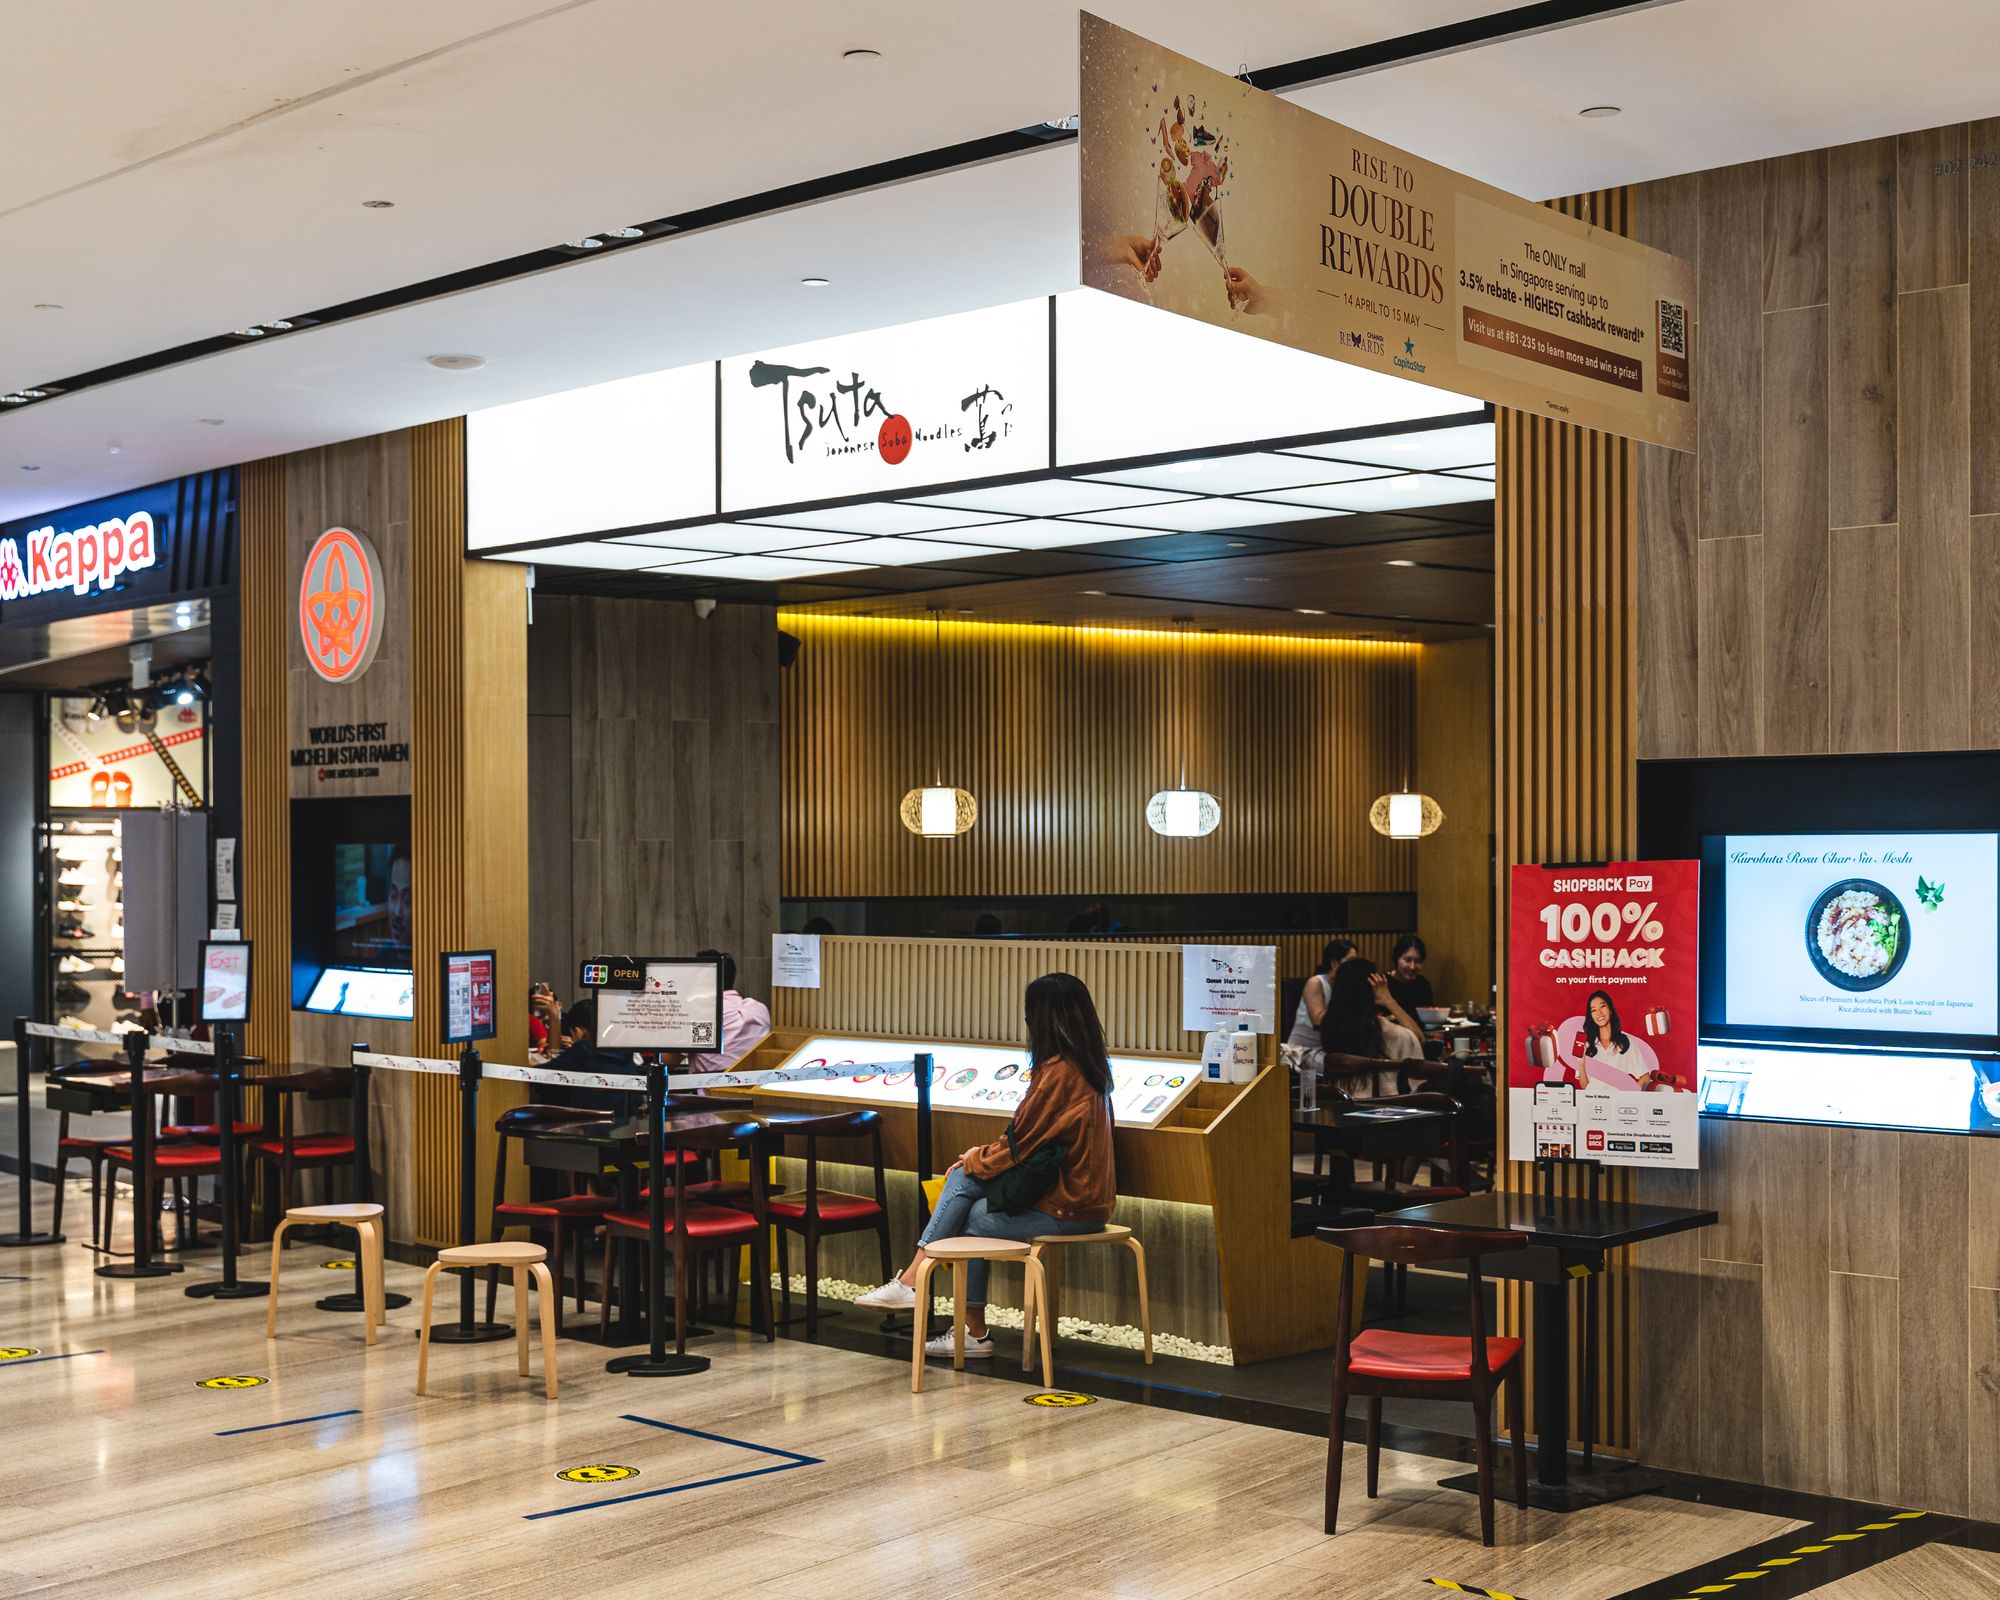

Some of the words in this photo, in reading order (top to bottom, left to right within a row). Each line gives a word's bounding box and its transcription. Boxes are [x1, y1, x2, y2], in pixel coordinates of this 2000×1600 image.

[1352, 148, 1388, 184] RISE
[1393, 165, 1414, 193] TO
[1329, 174, 1435, 252] DOUBLE
[1319, 223, 1444, 304] REWARDS
[1524, 242, 1540, 262] The
[1543, 250, 1567, 272] ONLY
[1569, 262, 1586, 279] mall
[1500, 258, 1508, 276] in
[1511, 262, 1553, 291] Singapore
[1556, 282, 1585, 306] serving
[1587, 293, 1598, 311] up
[1599, 295, 1609, 310] to
[1344, 293, 1353, 305] 14
[1355, 298, 1377, 315] APRIL
[1379, 303, 1390, 318] TO
[1392, 308, 1401, 322] 15
[1403, 312, 1421, 327] MAY
[1460, 269, 1485, 293] 3.5%
[1487, 281, 1517, 303] rebate
[1524, 291, 1564, 318] HIGHEST
[1566, 309, 1606, 333] cashback
[1467, 317, 1486, 335] Visit
[1486, 327, 1495, 337] us
[1497, 330, 1504, 341] at
[1505, 331, 1536, 351] #B1-235
[1537, 341, 1546, 353] to
[1547, 342, 1564, 360] learn
[1566, 350, 1584, 365] more
[1585, 354, 1599, 369] and
[1600, 360, 1613, 374] win
[1613, 365, 1618, 374] a
[1618, 365, 1638, 381] prize!
[1394, 356, 1426, 373] CapitaStar
[1662, 365, 1676, 376] SCAN
[750, 360, 895, 464] Tsuta
[881, 431, 907, 448] Soba
[915, 424, 962, 441] Noodles
[30, 518, 152, 588] Kappa
[309, 724, 356, 744] WORLD'S
[357, 722, 388, 742] FIRST
[291, 747, 338, 767] MICHELIN
[340, 745, 368, 764] STAR
[369, 743, 408, 762] RAMEN
[1729, 851, 1783, 864] Kurobuta
[1786, 851, 1818, 864] Rosu
[1822, 851, 1850, 864] Char
[1853, 851, 1873, 864] Siu
[1874, 851, 1912, 864] Meshi
[1553, 878, 1623, 893] SHOPBACK
[1629, 878, 1650, 890] Pay
[1540, 901, 1664, 943] 100%
[1539, 948, 1665, 968] CASHBACK
[614, 969, 639, 978] OPEN
[1569, 976, 1587, 985] your
[1589, 975, 1607, 984] first
[1608, 976, 1647, 985] payment
[1947, 999, 1974, 1008] Japanese
